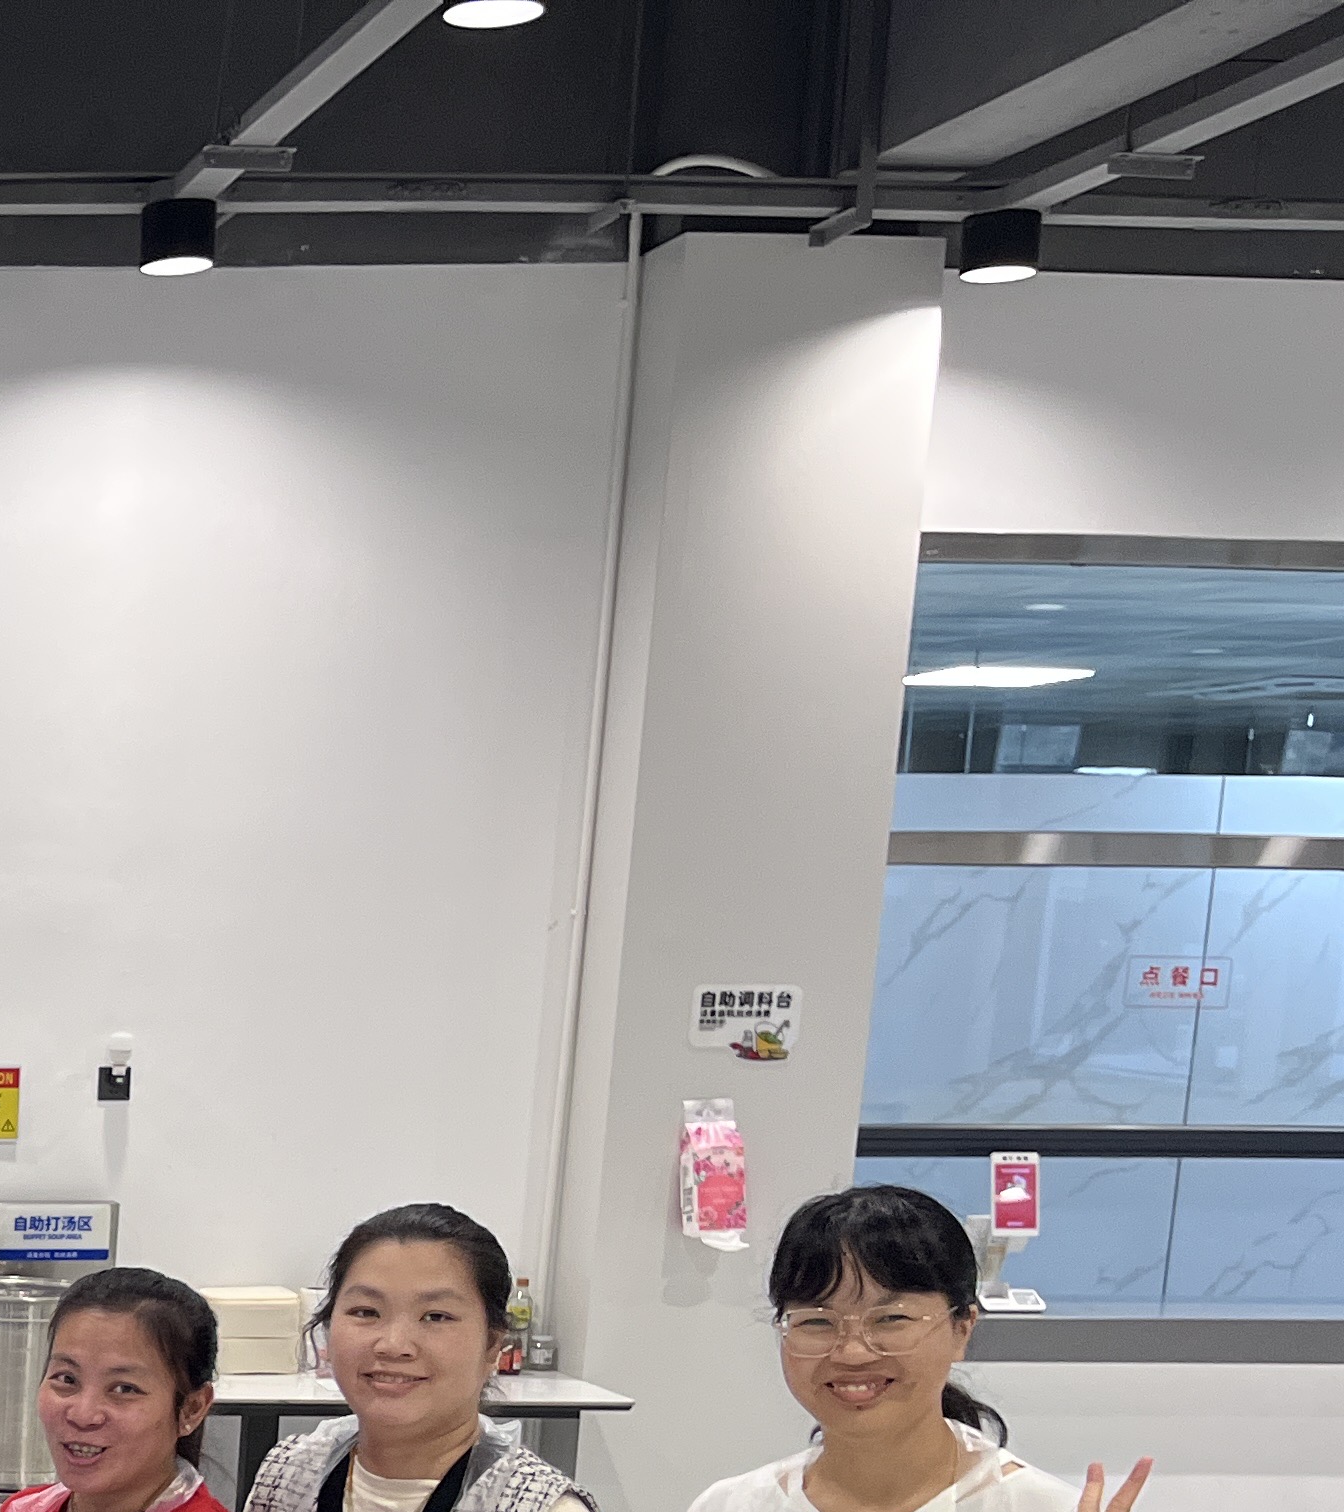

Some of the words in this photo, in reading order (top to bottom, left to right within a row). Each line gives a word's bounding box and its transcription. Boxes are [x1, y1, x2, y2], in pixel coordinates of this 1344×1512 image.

[1140, 966, 1218, 986] 点餐口
[701, 989, 792, 1009] 自助调料台
[14, 1216, 93, 1231] 自助打汤区
